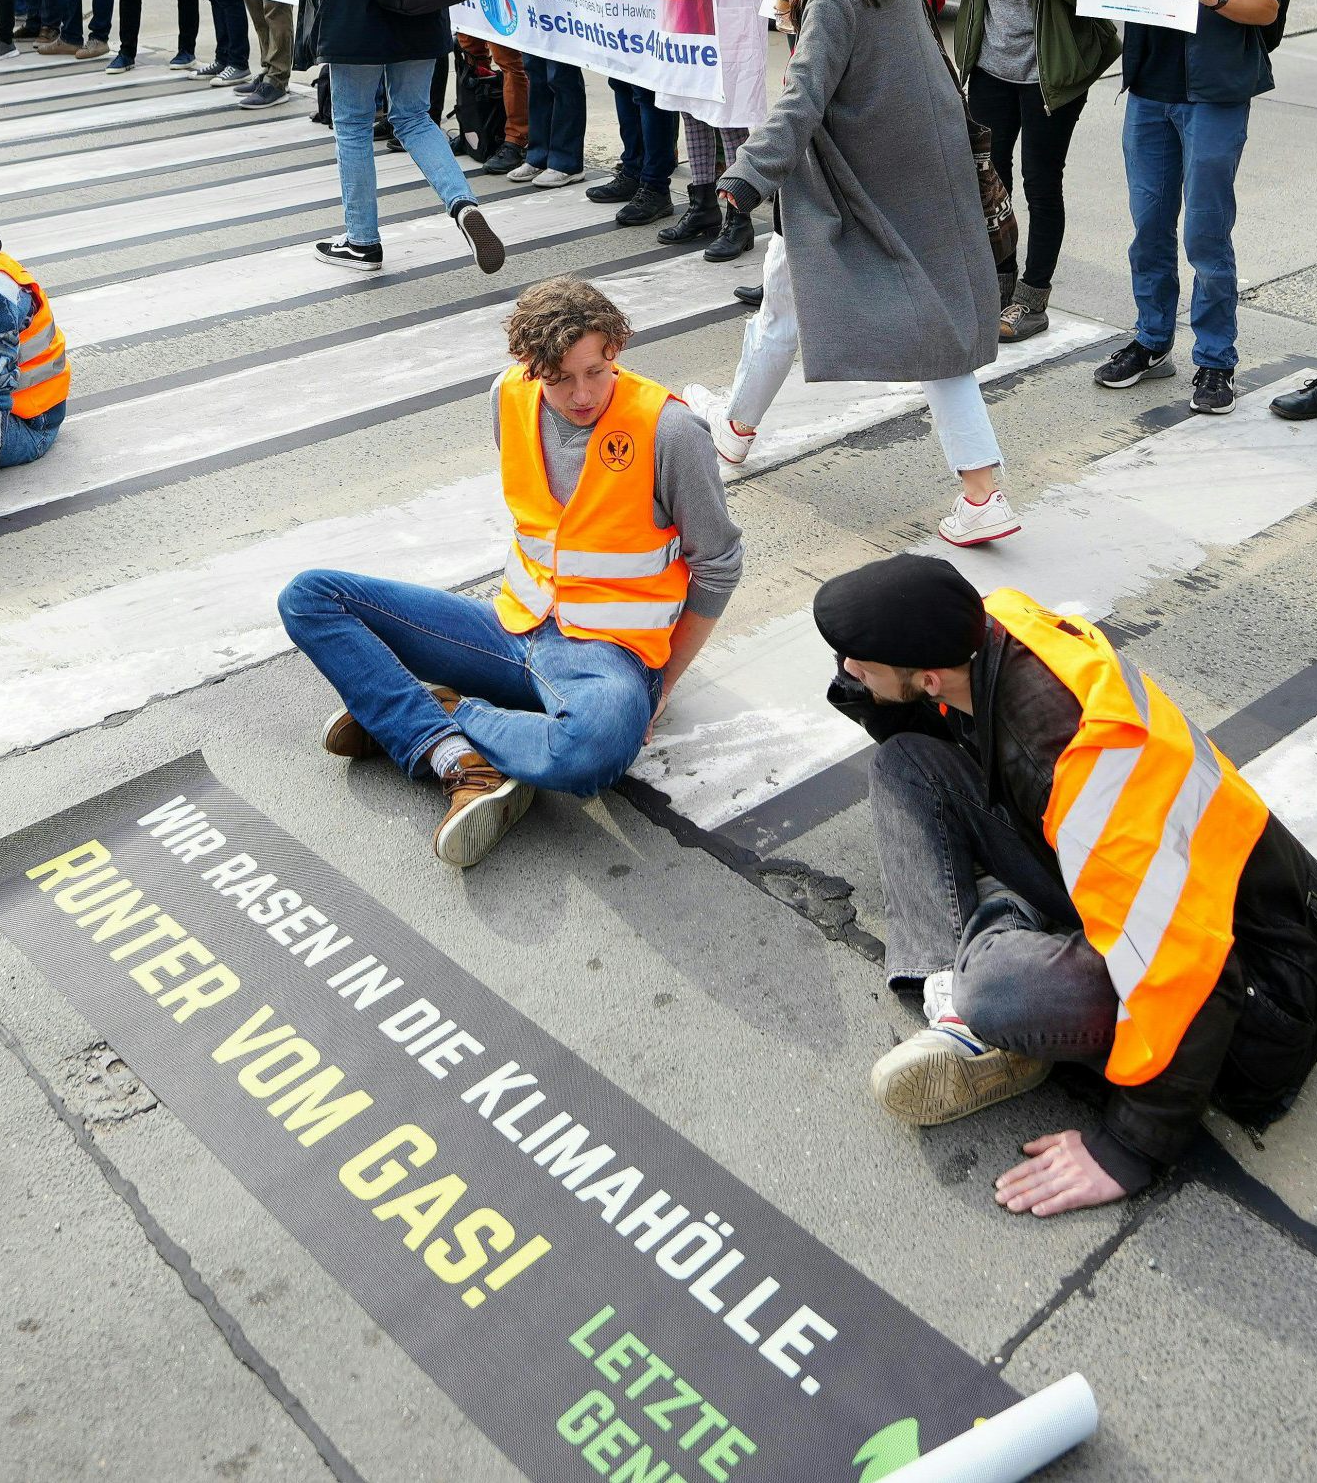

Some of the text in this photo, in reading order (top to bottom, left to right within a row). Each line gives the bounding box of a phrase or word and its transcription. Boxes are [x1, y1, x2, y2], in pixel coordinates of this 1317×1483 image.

[527, 5, 718, 67] #scientists4future
[595, 4, 604, 18] by
[605, 3, 619, 17] Ed
[622, 4, 656, 20] Hawkins
[24, 837, 553, 1309] RUNTER VOM GAS!
[135, 794, 839, 1397] WIR RASEN IN DIE KLIMAHÖLLE.
[567, 1304, 759, 1483] LETZTE
